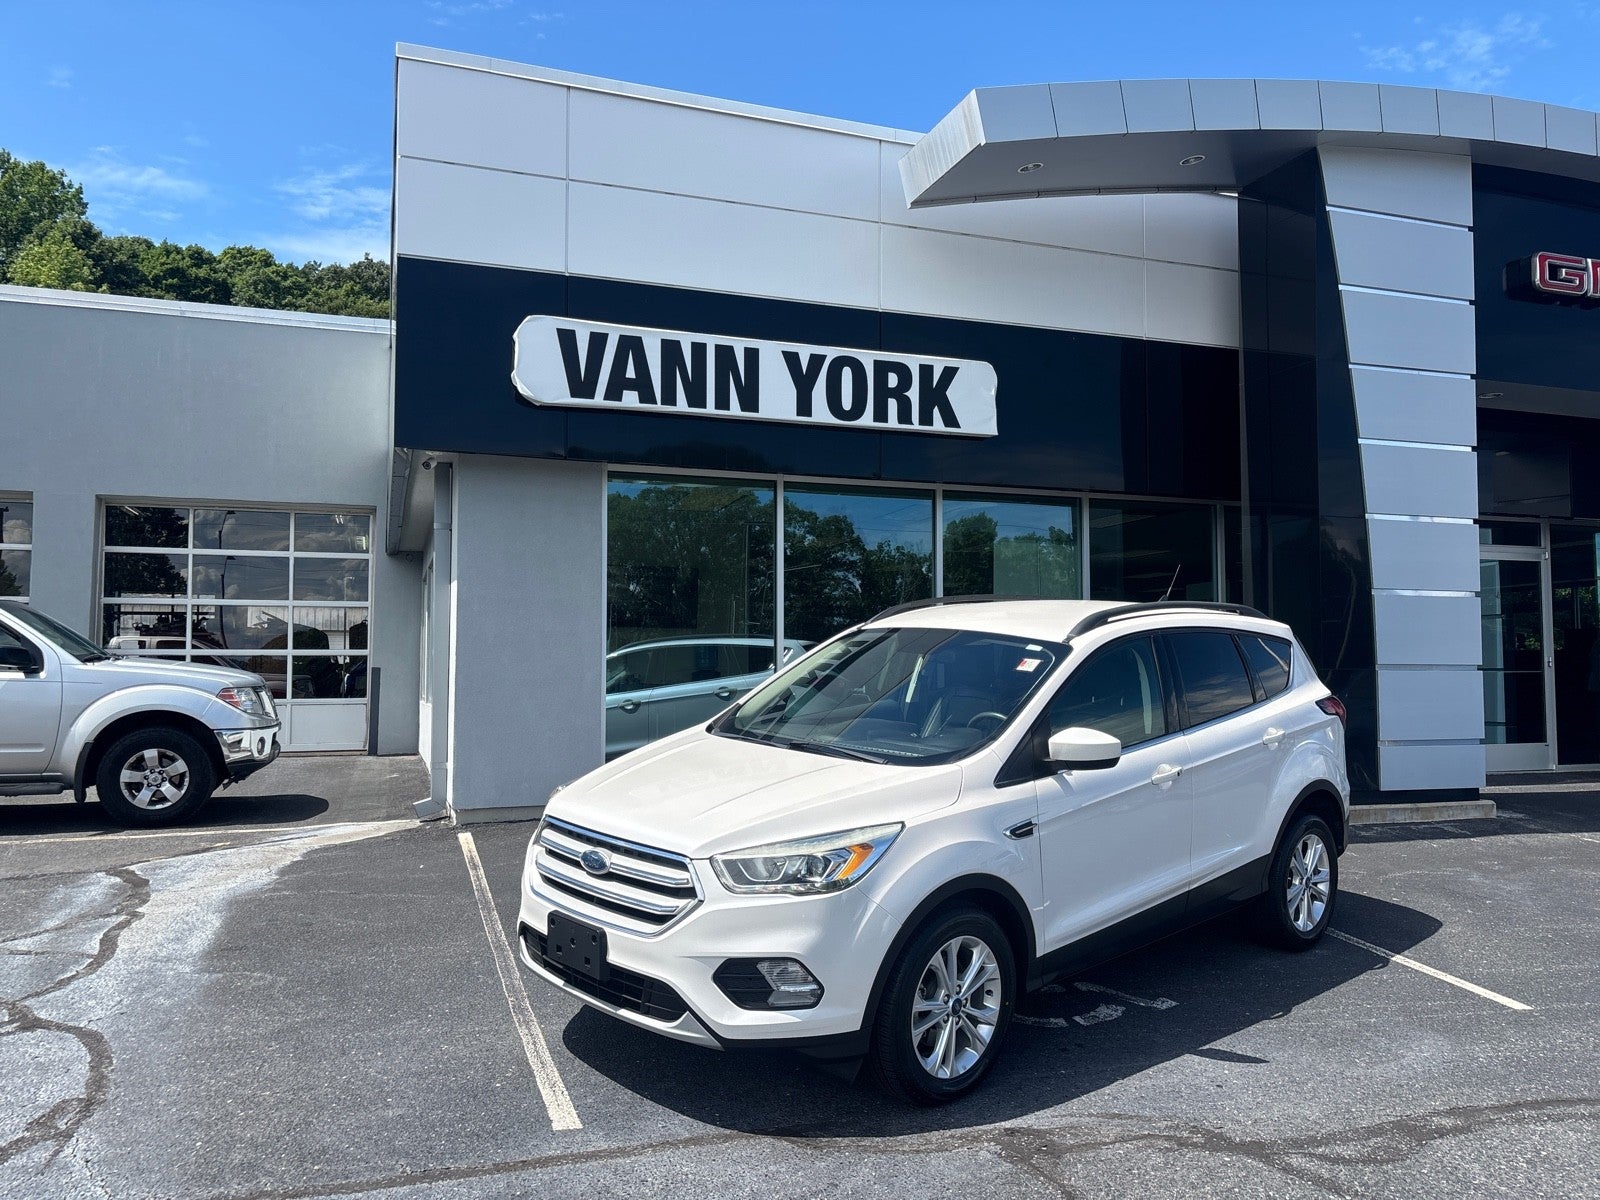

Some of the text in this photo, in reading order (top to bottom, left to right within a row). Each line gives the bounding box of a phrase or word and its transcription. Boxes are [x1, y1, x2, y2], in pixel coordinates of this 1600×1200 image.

[1534, 251, 1600, 297] G
[555, 327, 962, 429] VANN YORK
